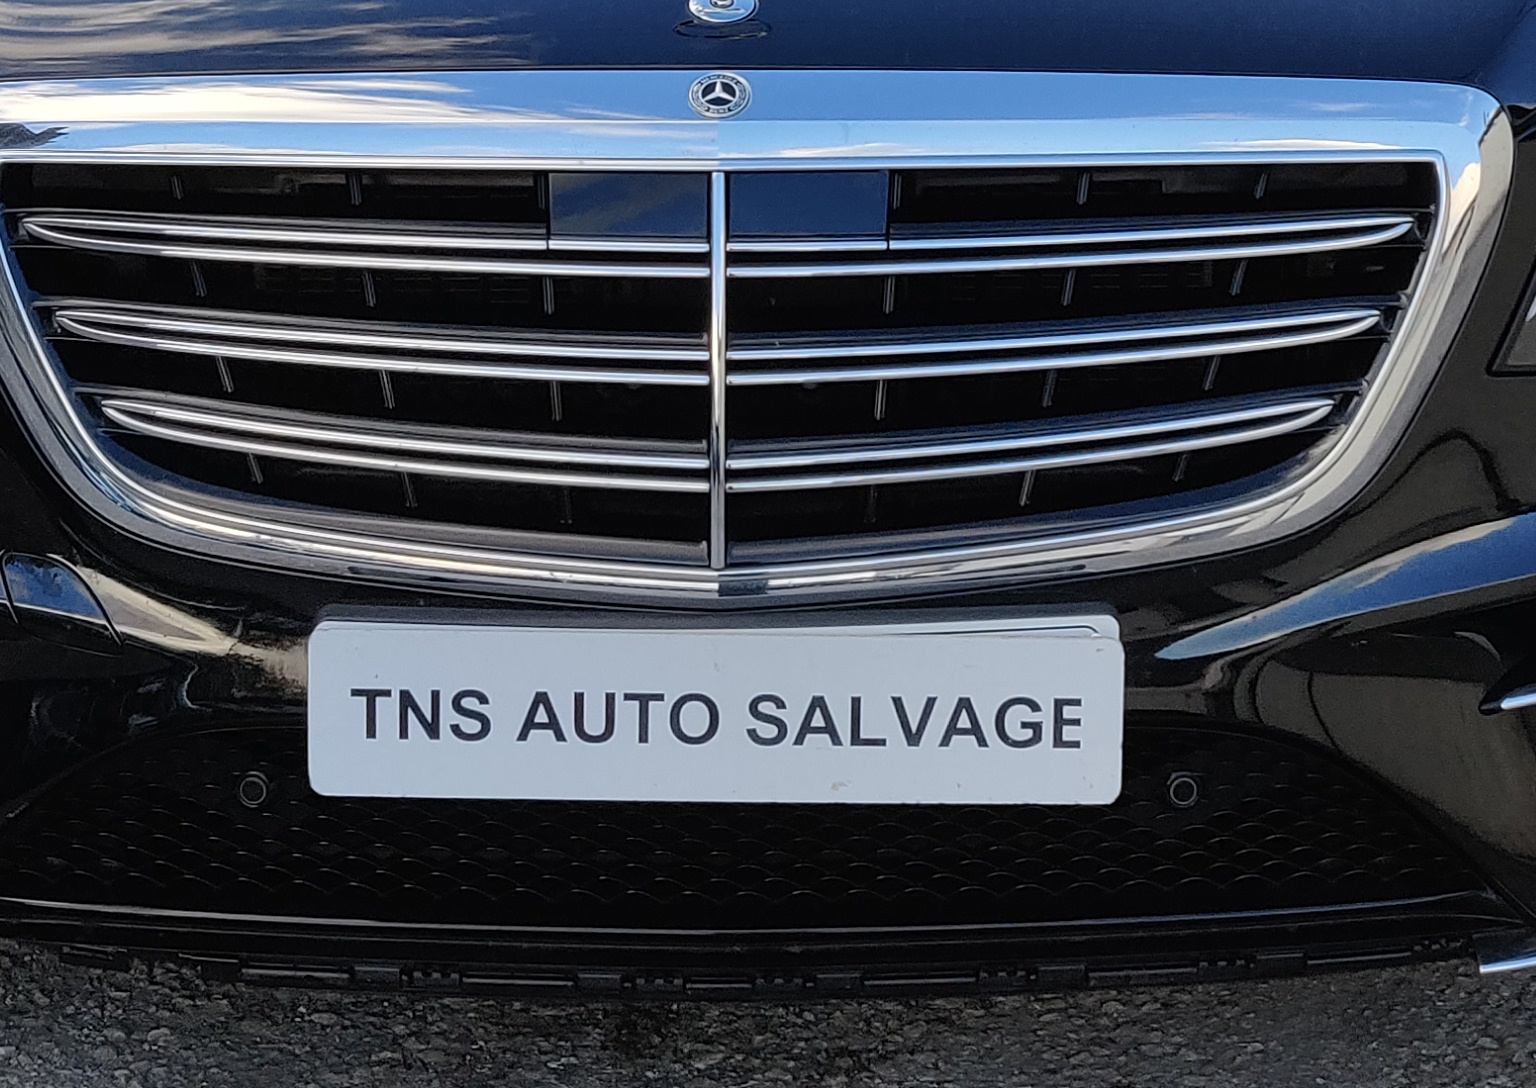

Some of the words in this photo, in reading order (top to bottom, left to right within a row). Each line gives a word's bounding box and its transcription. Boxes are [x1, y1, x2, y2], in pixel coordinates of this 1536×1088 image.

[350, 688, 492, 742] TNS
[516, 690, 721, 745] AUTO
[746, 694, 1083, 749] SALVAGE
